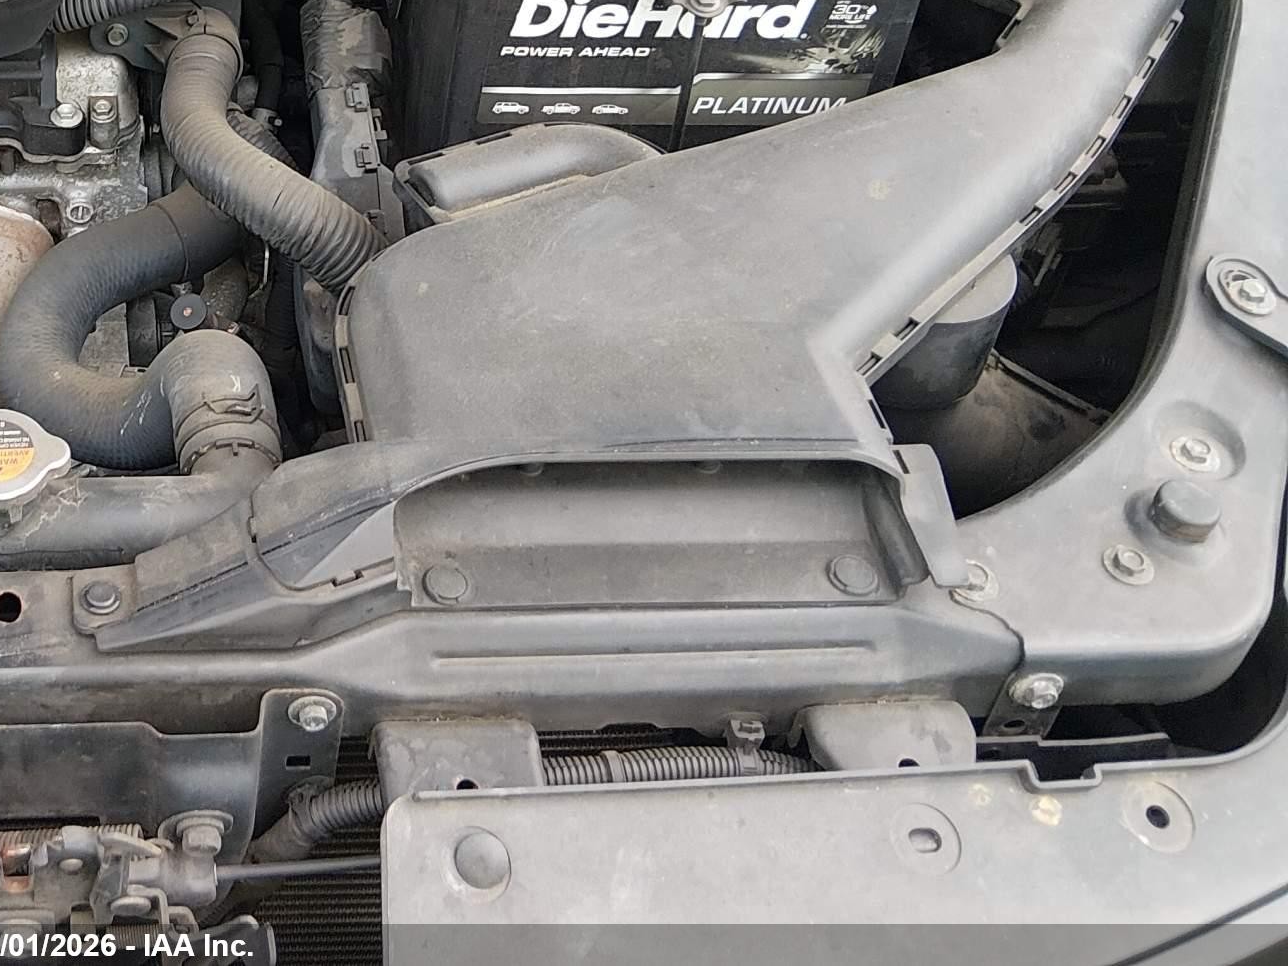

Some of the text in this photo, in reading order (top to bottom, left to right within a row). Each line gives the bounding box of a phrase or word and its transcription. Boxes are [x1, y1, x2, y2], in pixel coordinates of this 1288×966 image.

[500, 46, 650, 58] POWER AHEAD
[692, 97, 846, 116] PLATINUM
